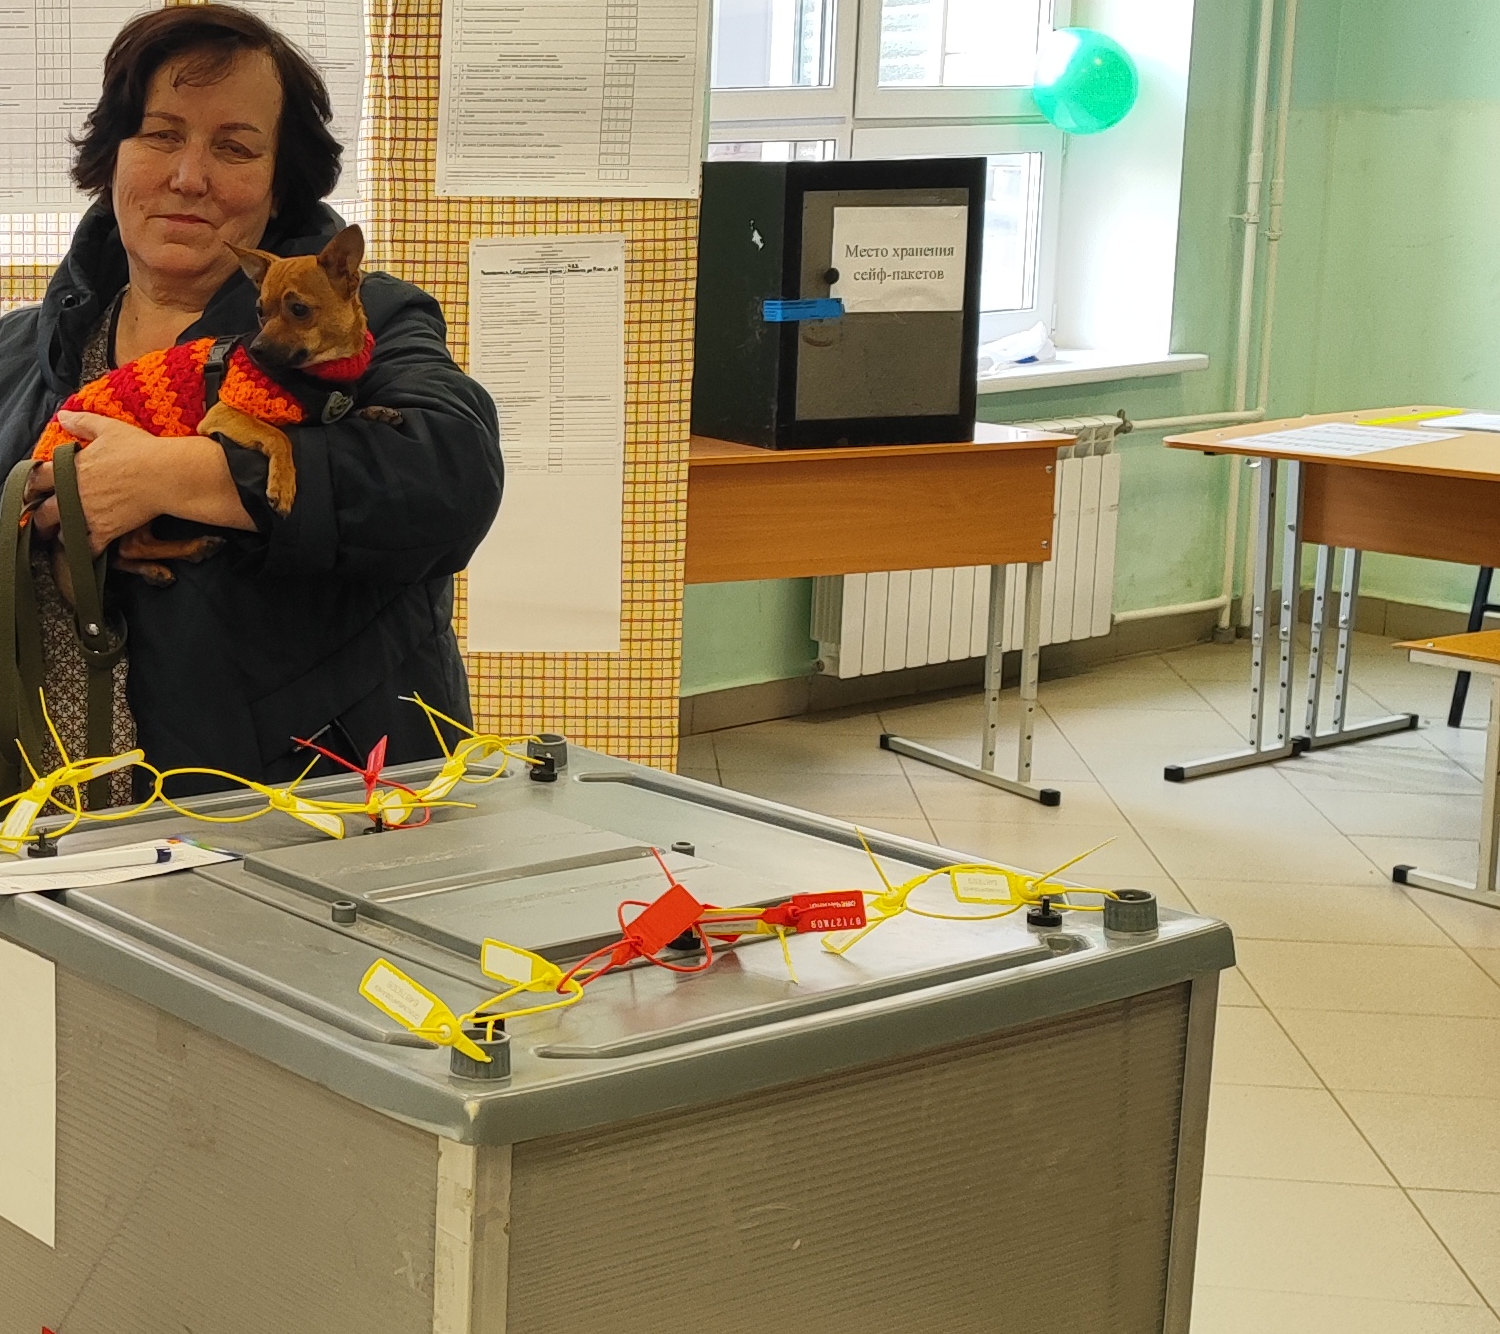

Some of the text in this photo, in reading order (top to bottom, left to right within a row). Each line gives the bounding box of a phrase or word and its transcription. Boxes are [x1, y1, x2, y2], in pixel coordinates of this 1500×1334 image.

[845, 243, 955, 260] Место хранения
[853, 267, 945, 284] сейф-пакетов
